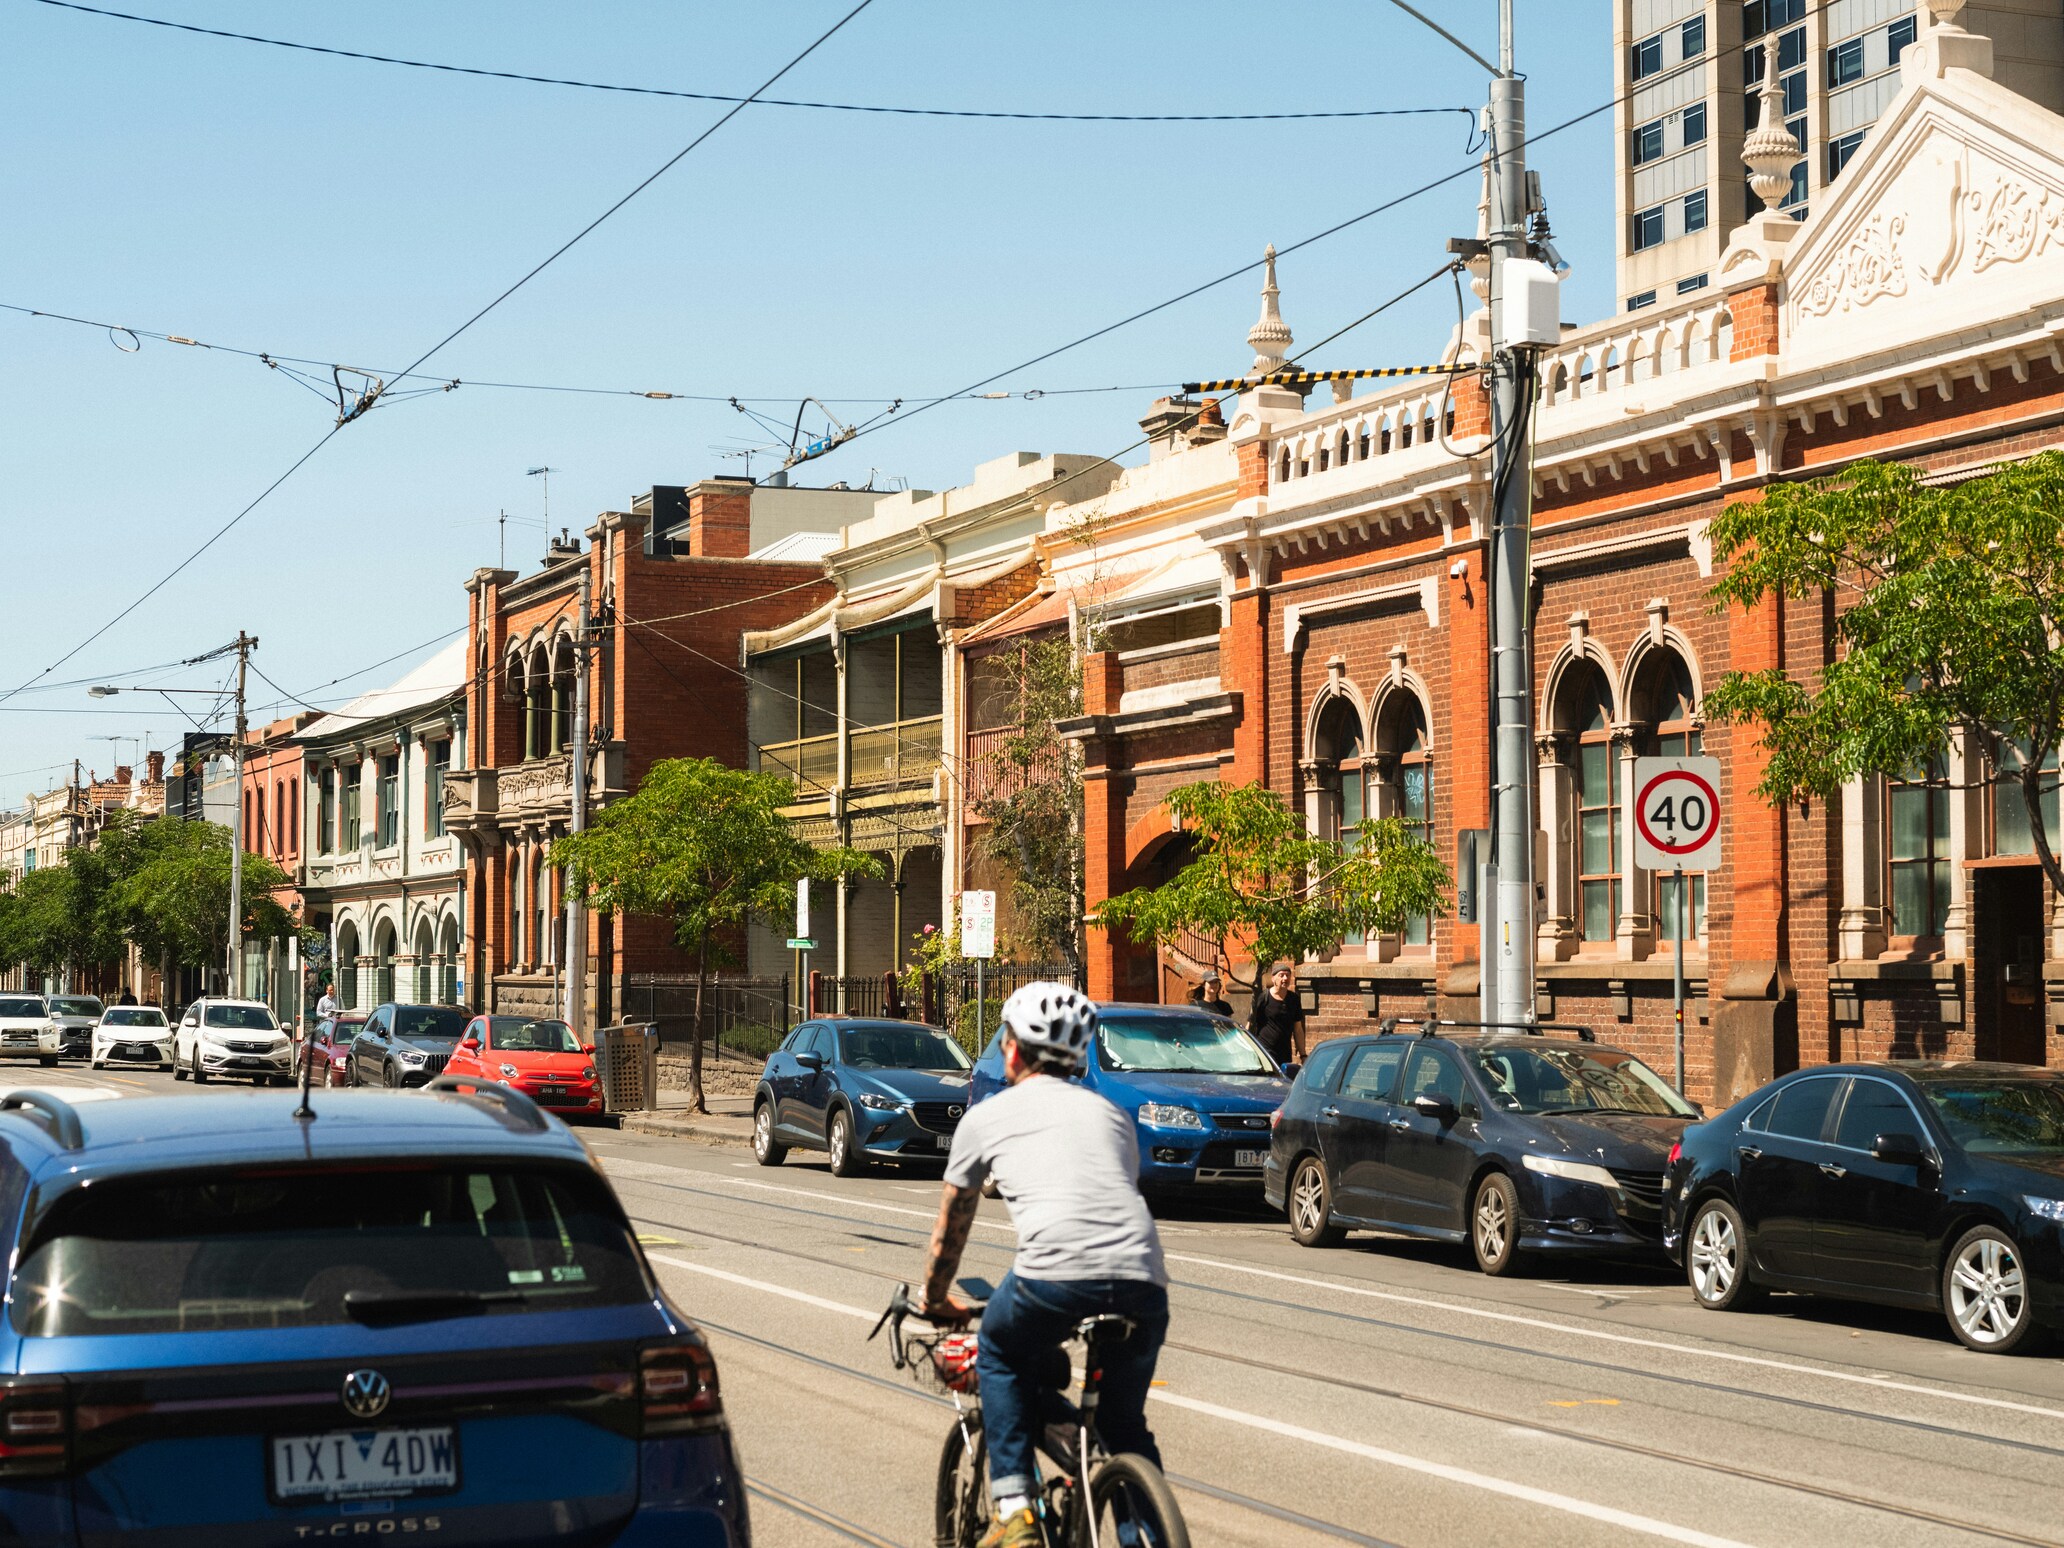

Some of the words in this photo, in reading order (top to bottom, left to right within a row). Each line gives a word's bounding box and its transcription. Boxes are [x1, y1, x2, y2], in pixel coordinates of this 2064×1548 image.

[1650, 795, 1706, 832] 40
[980, 916, 994, 928] 2P
[284, 1440, 347, 1483] 1XI
[382, 1434, 452, 1476] 4DW
[294, 1516, 442, 1538] T-CROSS
